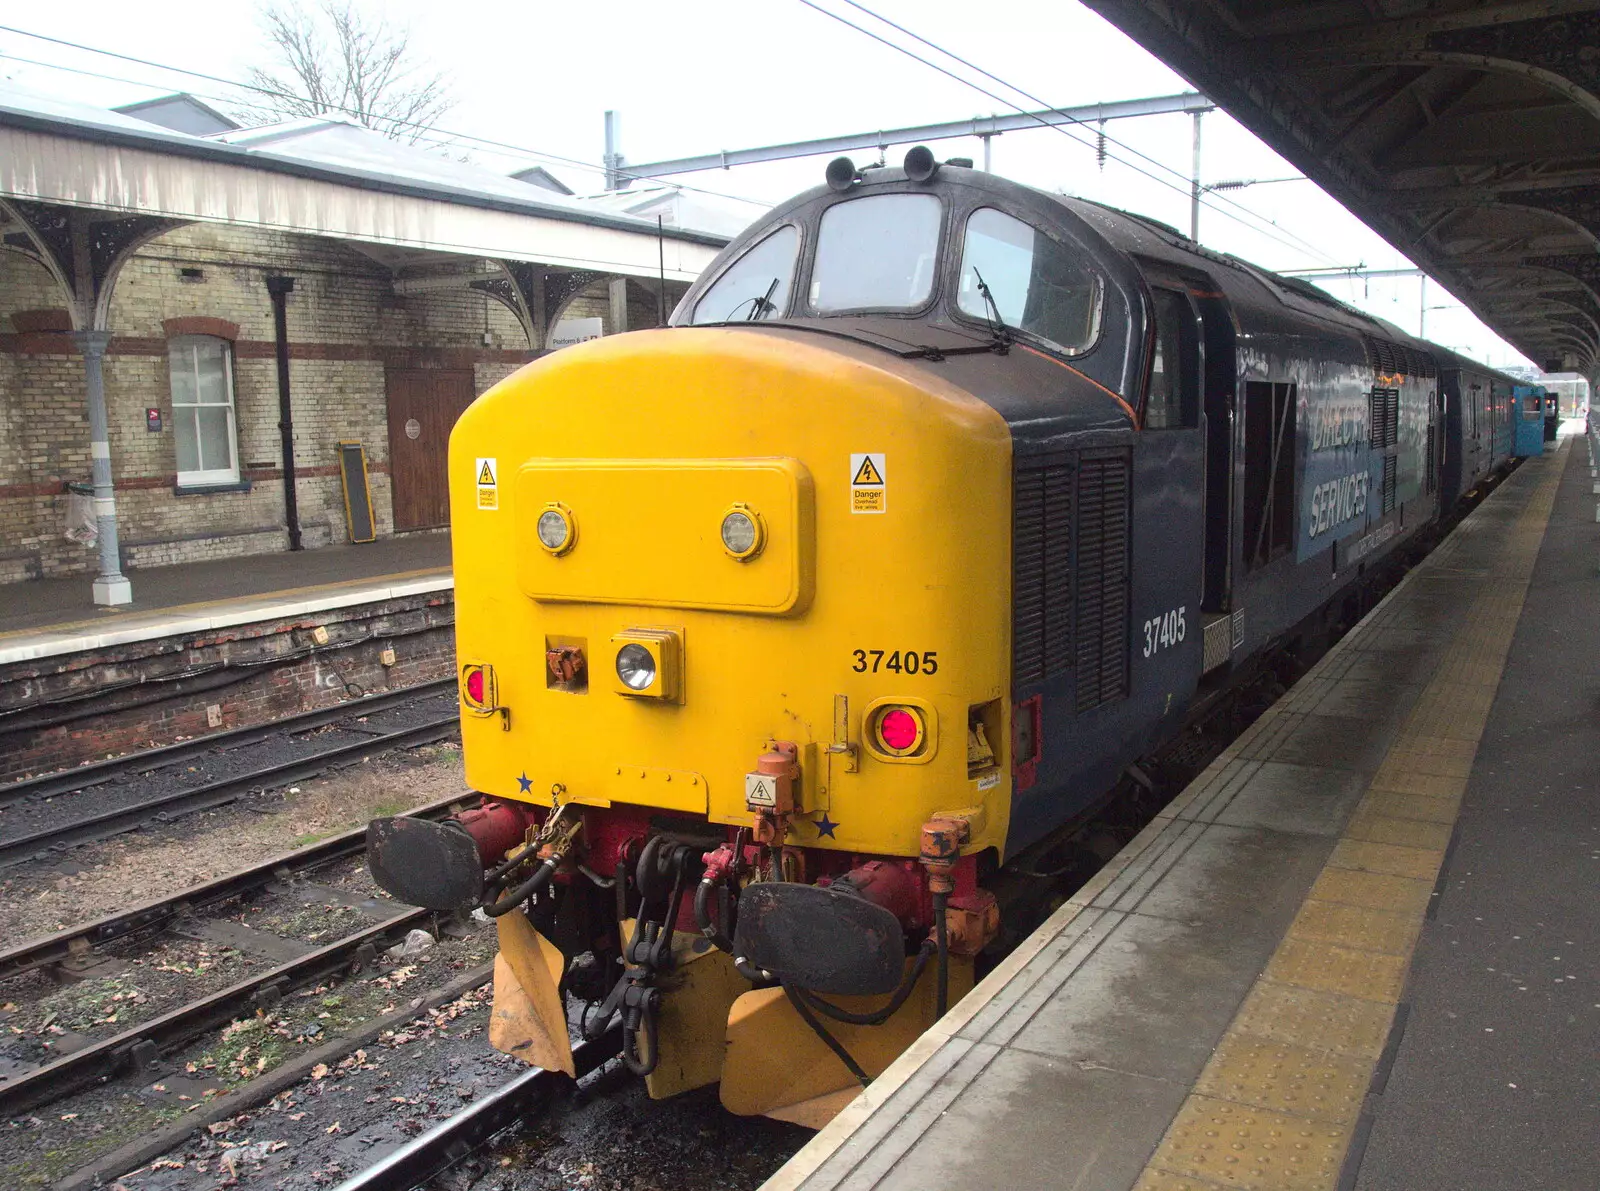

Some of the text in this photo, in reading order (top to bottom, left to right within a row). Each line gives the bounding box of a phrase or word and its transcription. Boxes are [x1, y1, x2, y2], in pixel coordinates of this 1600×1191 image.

[855, 490, 882, 499] Danger
[1309, 469, 1369, 538] SERVICES
[1143, 606, 1186, 658] 37405
[852, 648, 938, 675] 37405
